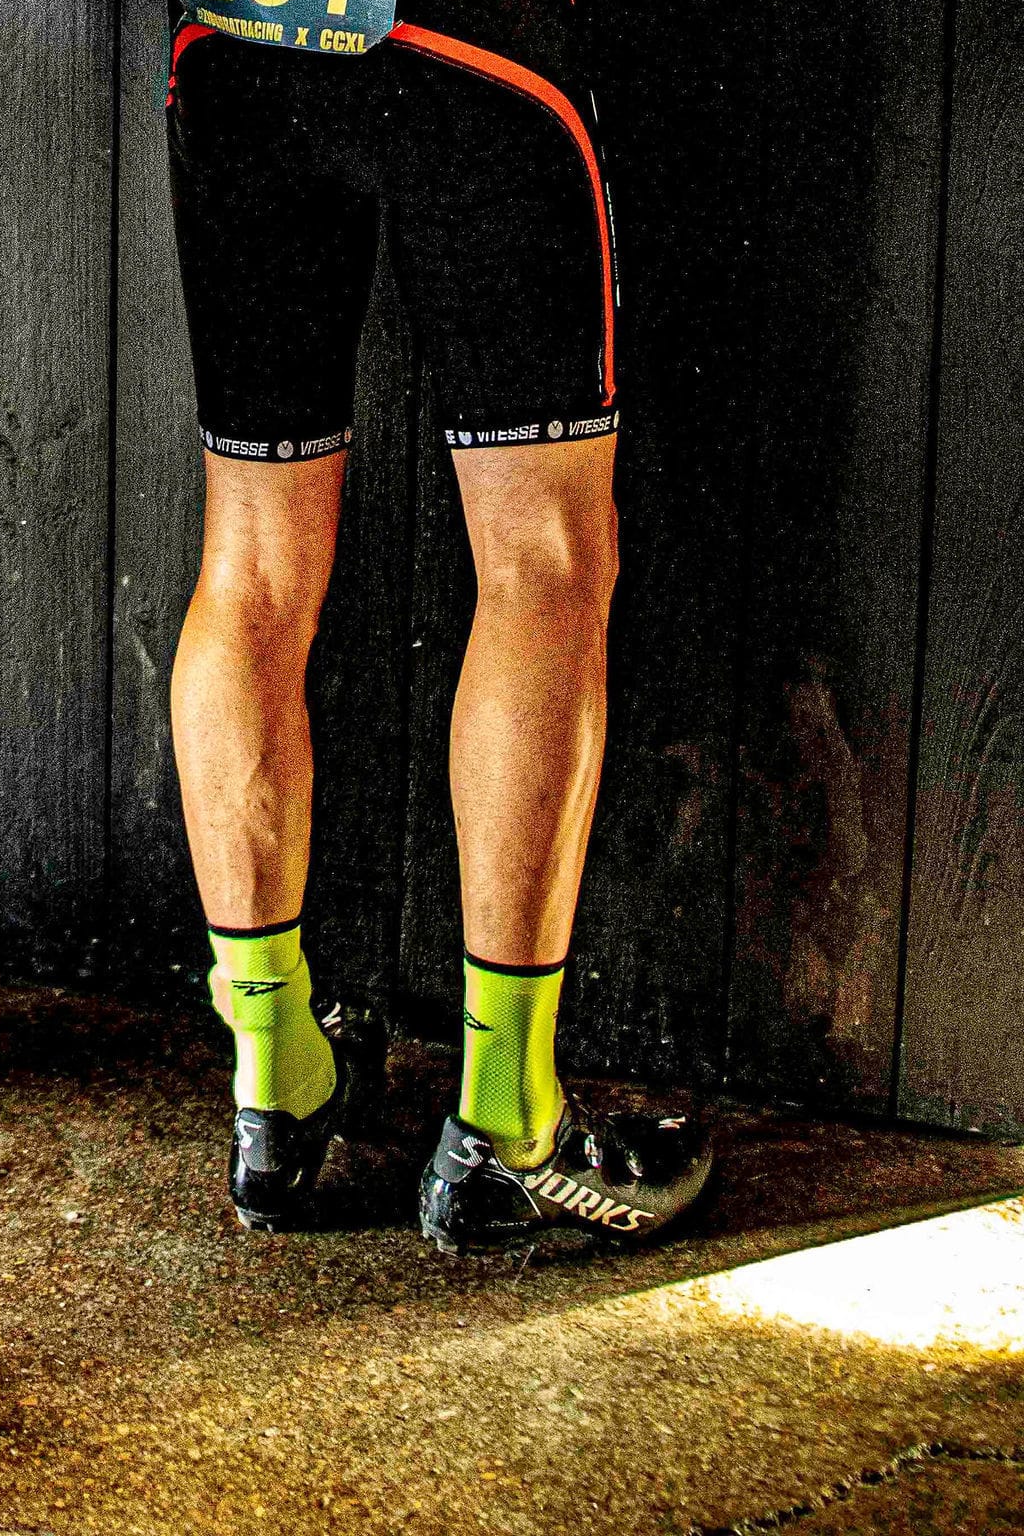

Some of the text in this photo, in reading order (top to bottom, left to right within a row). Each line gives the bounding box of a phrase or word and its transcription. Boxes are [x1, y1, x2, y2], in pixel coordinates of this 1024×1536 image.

[319, 28, 368, 54] CCXL
[568, 415, 612, 436] VITESSE
[215, 432, 343, 457] VITESSE VITESSE
